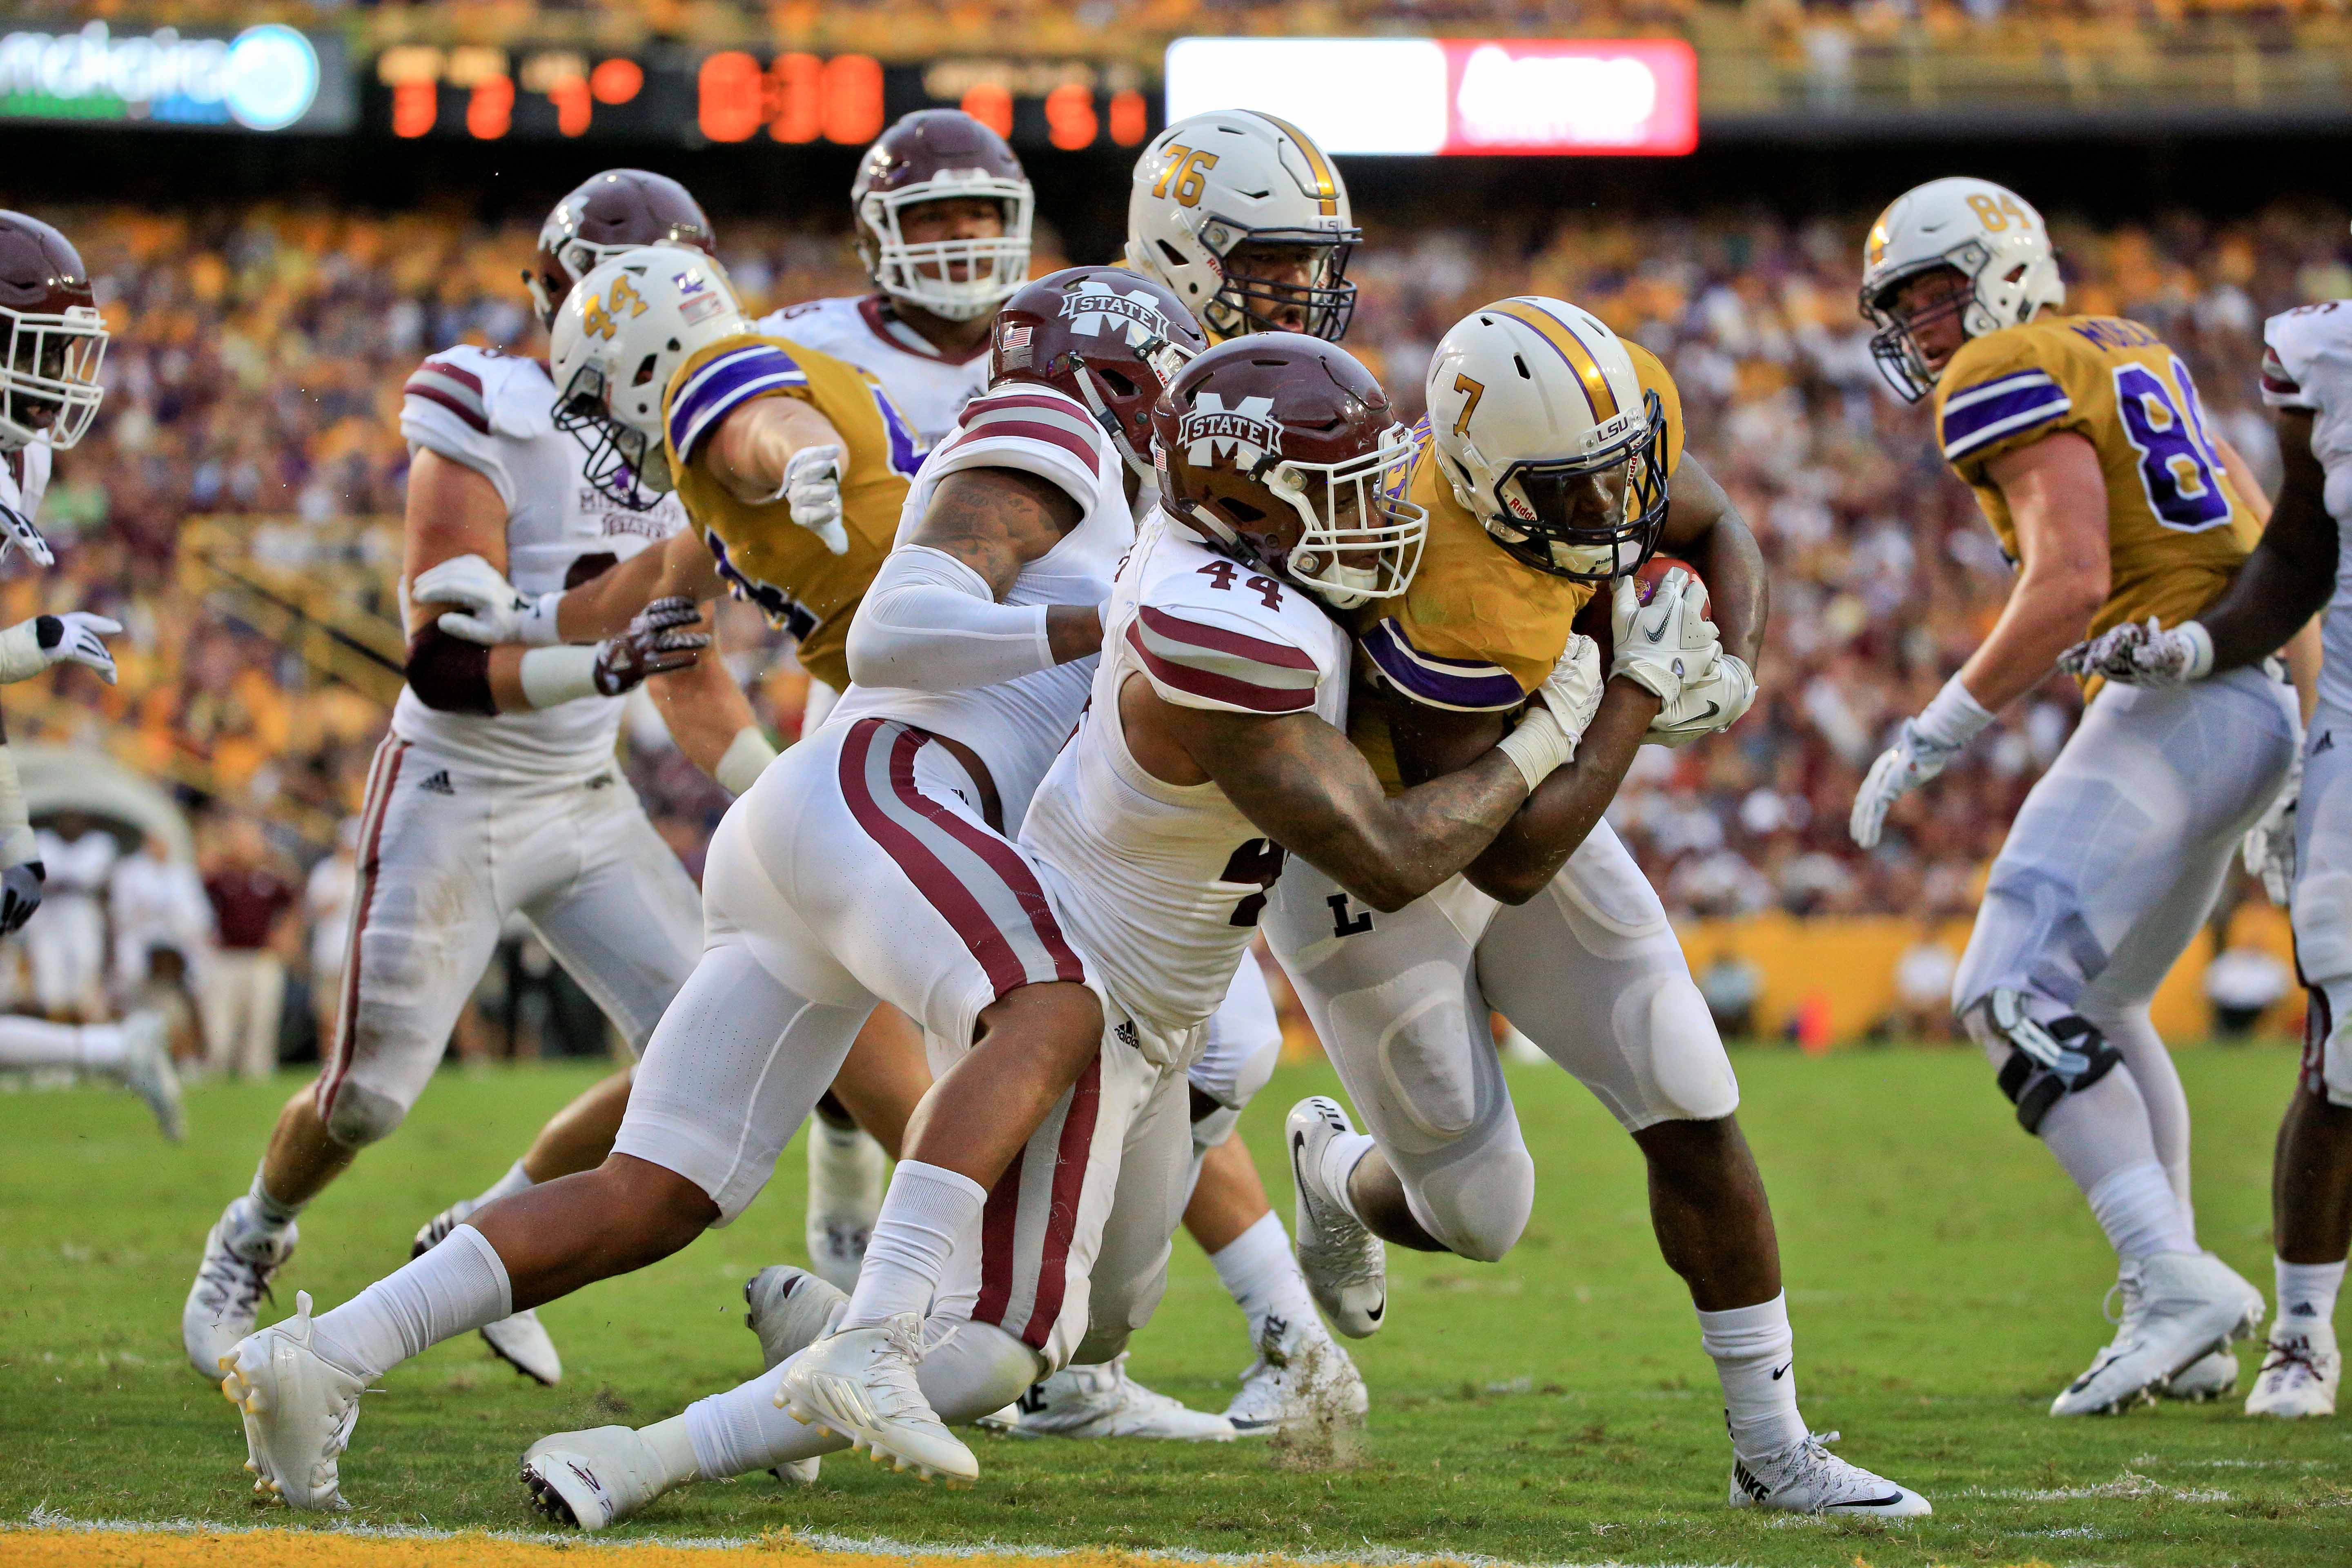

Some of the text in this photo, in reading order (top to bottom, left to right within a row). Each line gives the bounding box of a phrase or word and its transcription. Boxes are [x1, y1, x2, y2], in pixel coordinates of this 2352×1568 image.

[1152, 144, 1220, 208] 76
[1966, 194, 2032, 232] 84
[583, 274, 650, 341] 44
[1079, 296, 1154, 329] STATE
[1453, 372, 1485, 441] 7
[1192, 416, 1263, 445] STATE
[1597, 416, 1628, 442] LSU
[1196, 560, 1283, 612] 44
[1734, 1459, 1771, 1501] NIKE
